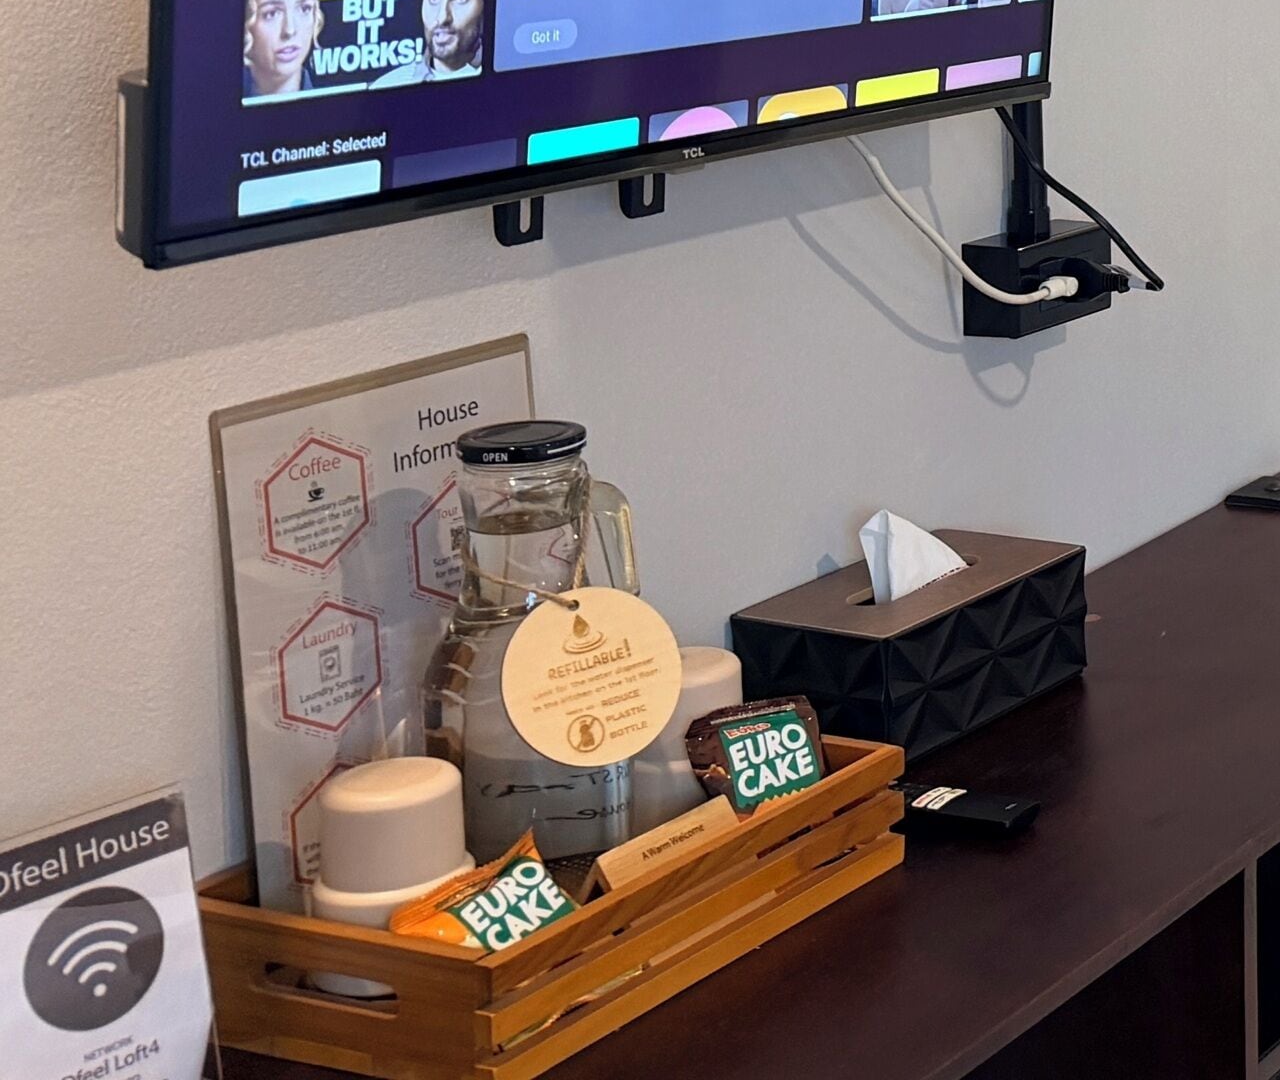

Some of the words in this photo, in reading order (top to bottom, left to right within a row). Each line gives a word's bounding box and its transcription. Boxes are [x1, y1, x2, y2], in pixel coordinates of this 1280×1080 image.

[357, 19, 384, 45] IT
[532, 30, 550, 44] Got
[552, 28, 560, 42] it
[313, 38, 423, 75] WORKS!
[241, 151, 268, 170] TCL
[272, 142, 329, 165] Channel:
[332, 132, 386, 154] Selected
[682, 146, 704, 160] TCL
[418, 400, 479, 430] House
[288, 456, 342, 481] Coffee
[482, 452, 508, 462] OPEN
[302, 620, 357, 649] Laundry
[548, 638, 632, 680] REFILLABLE!
[298, 687, 334, 704] Laundry
[601, 689, 640, 706] REDUCE
[606, 704, 648, 722] PLASTIC
[609, 720, 648, 739] BOTTLE
[728, 723, 807, 772] EURO
[738, 746, 814, 798] CAKE
[642, 850, 650, 861] A
[646, 840, 672, 857] Warm
[668, 824, 705, 846] Welcome
[0, 846, 69, 896] feel
[76, 819, 170, 868] House
[460, 861, 546, 934] EURO
[486, 878, 566, 951] CAKE
